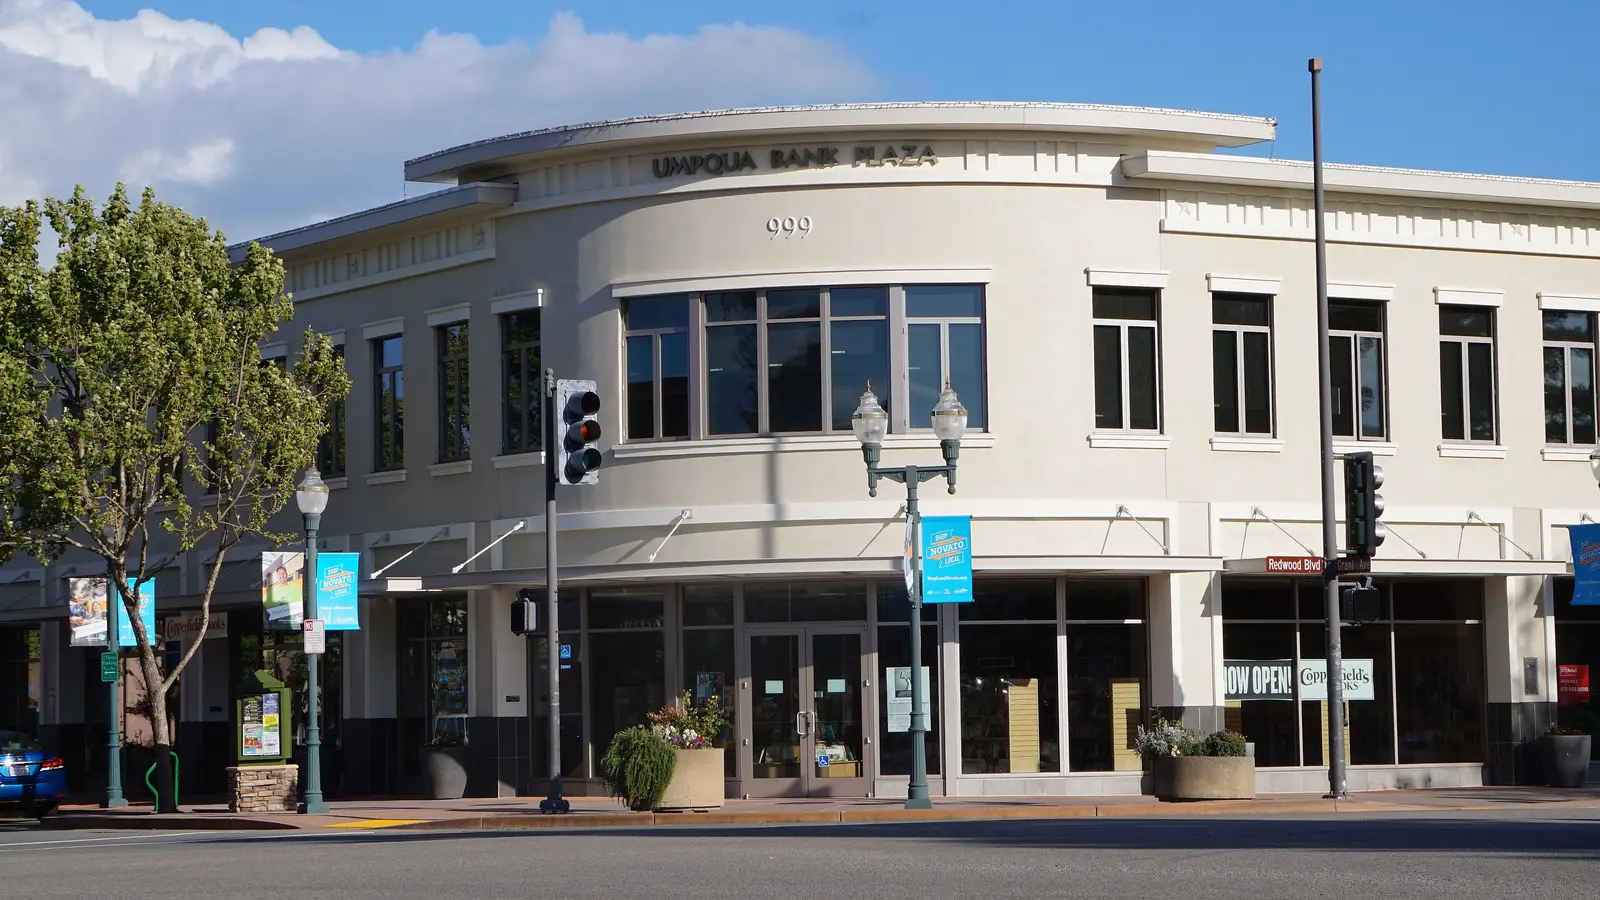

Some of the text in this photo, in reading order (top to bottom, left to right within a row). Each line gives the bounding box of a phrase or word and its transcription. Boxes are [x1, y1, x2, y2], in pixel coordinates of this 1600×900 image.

[652, 145, 939, 178] UMPQUA BANK PLAZA
[766, 216, 813, 240] 999
[934, 532, 949, 541] SHOP
[929, 540, 964, 556] NOVATO
[944, 555, 961, 565] LOCAL
[1268, 558, 1320, 571] Redwood Blvd
[1337, 559, 1370, 571] Grant Ave
[327, 567, 340, 576] SHOP
[323, 575, 352, 588] NOVATO
[305, 621, 313, 631] NO
[1252, 665, 1292, 694] OPEN!
[1300, 667, 1370, 686] Coppield's
